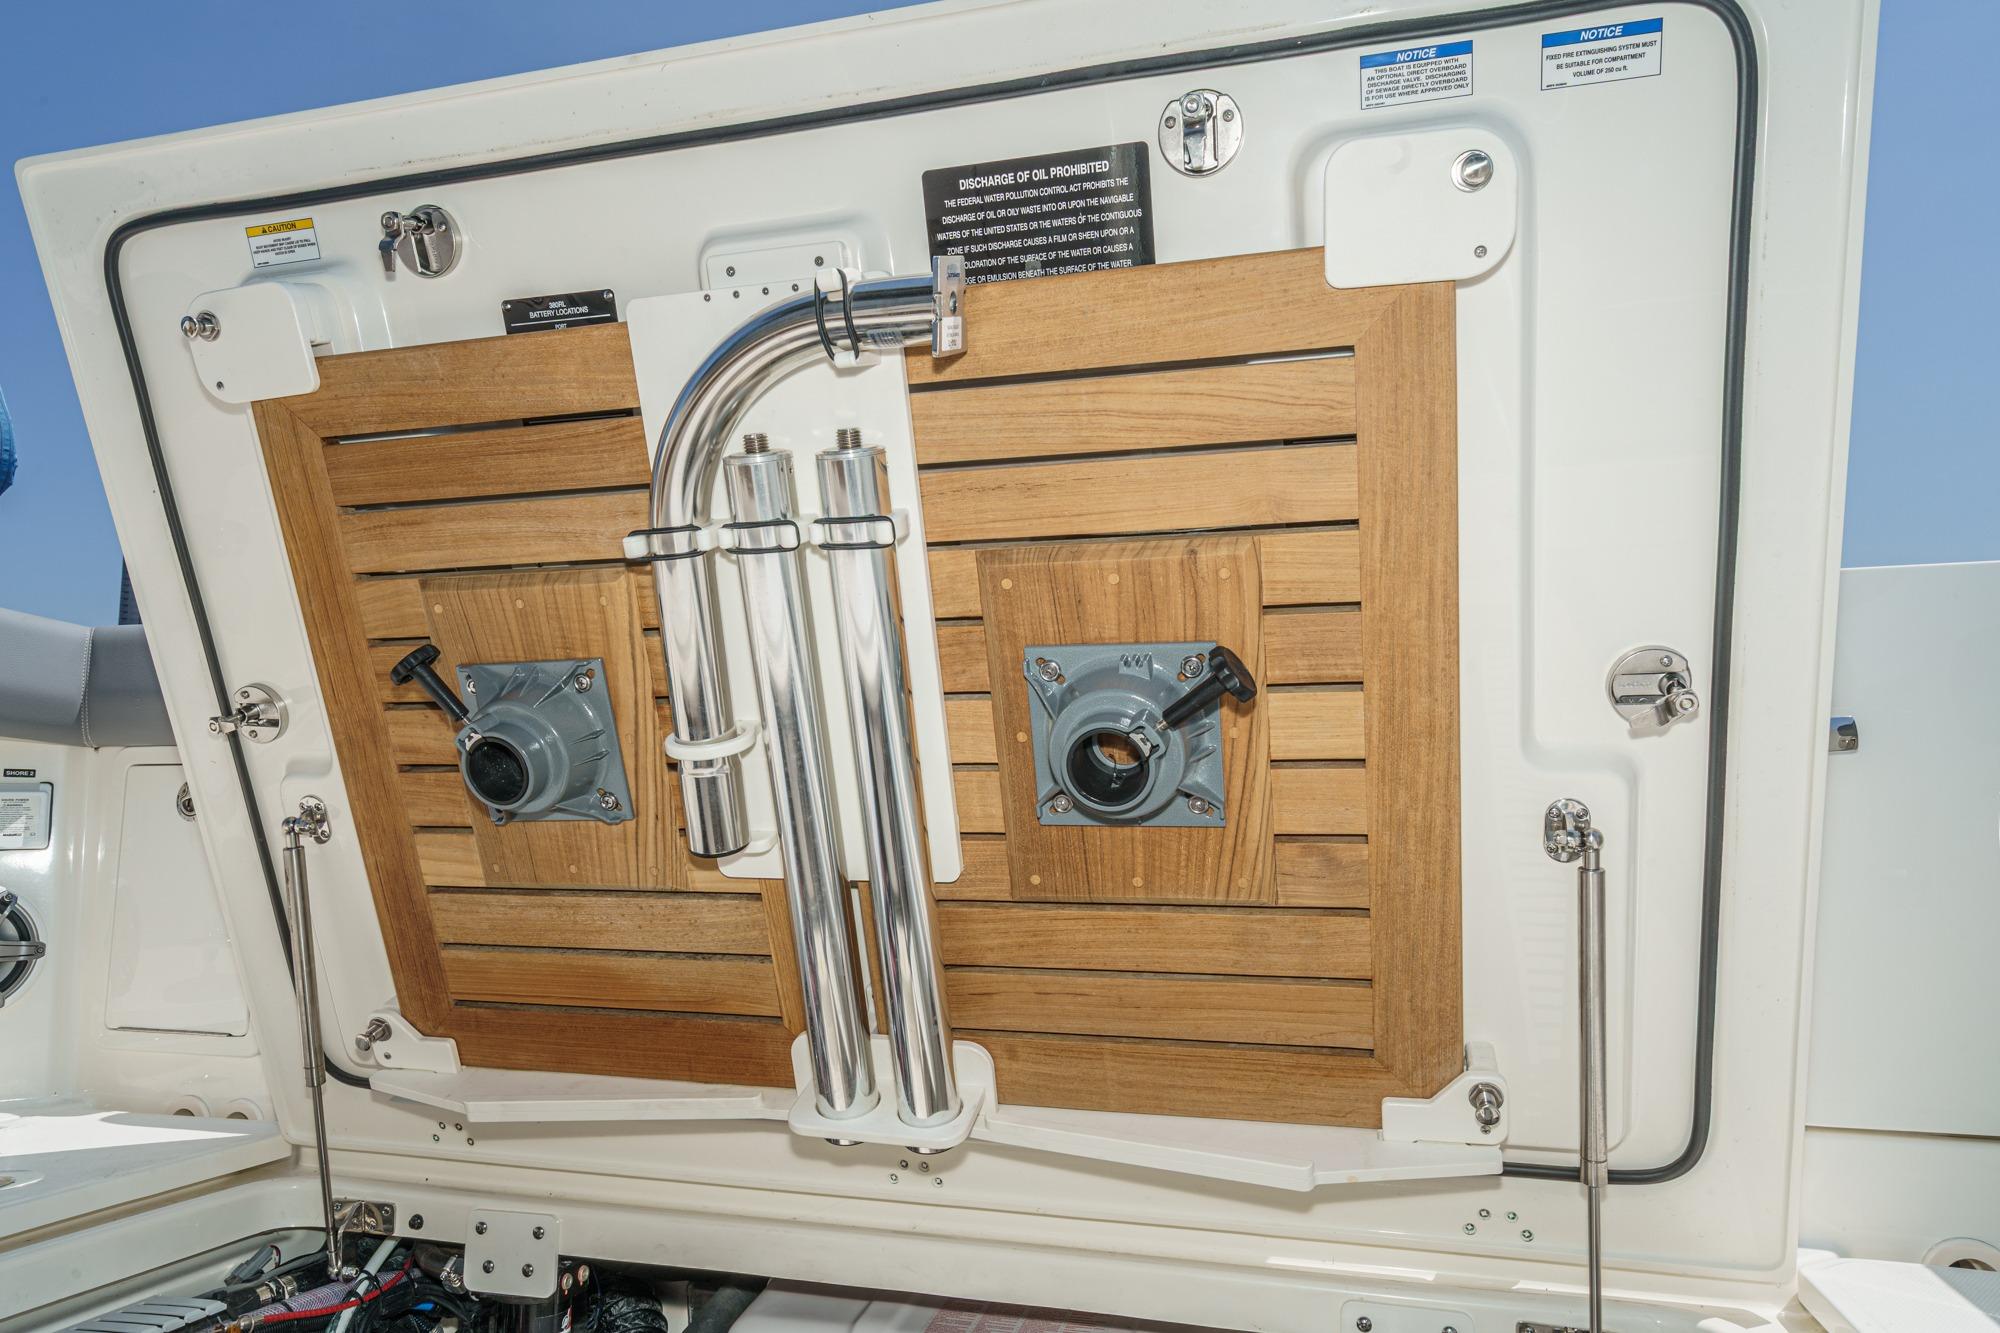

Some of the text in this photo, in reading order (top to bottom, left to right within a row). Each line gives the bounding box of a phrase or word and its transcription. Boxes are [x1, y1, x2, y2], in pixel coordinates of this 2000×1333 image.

[1580, 26, 1623, 40] NOTICE
[1397, 48, 1436, 62] NOTICE
[1576, 46, 1617, 57] EXTINGUISHING
[1619, 42, 1640, 51] SYSTEM
[1413, 60, 1442, 68] EQUIPPED
[1565, 60, 1590, 68] SUITABLE
[1604, 52, 1646, 63] COMPARTMENT
[1368, 79, 1401, 88] DISCHARGE
[1425, 70, 1466, 80] DISCHARGING
[1376, 72, 1405, 80] OPTIONAL
[1430, 63, 1467, 73] OVERBOARD
[1402, 82, 1429, 90] DIRECTLY
[1431, 77, 1468, 86] OVERBOARD
[1421, 85, 1452, 93] APPROVED
[959, 161, 1109, 190] DISCHARGE OF OIL PROHIBITED
[944, 177, 1128, 208] THE FEDERAL WATER POLLUTION CONTROL ACT PROHIBITS THE
[942, 193, 1134, 224] DISCHARGE OF OIL OR OILY WASTE INTO OR UPON THE NAVIGABLE
[268, 222, 296, 233] CAUTION
[937, 209, 1142, 241] WATERS OF THE UNITED STATES OR THE WATERS OF THE CONTIGUOUS
[947, 246, 963, 255] ZONE
[971, 244, 987, 253] SUCH
[988, 240, 1023, 251] DISCHARGE
[1023, 237, 1047, 246] CAUSES
[1048, 236, 1053, 244] A
[1054, 234, 1067, 243] FILM
[1068, 233, 1077, 241] OR
[1078, 230, 1099, 240] SHEEN
[1100, 228, 1118, 238] UPON
[1119, 227, 1128, 235] OR
[1129, 226, 1134, 234] A
[964, 259, 997, 269] OLORATION
[997, 258, 1006, 266] OF
[1007, 256, 1019, 265] THE
[1020, 252, 1047, 263] SURFACE
[1048, 252, 1056, 260] OF
[1058, 250, 1070, 259] THE
[1070, 248, 1092, 257] WATER
[1092, 247, 1102, 255] OR
[1102, 244, 1128, 254] CAUSES
[977, 274, 986, 283] OR
[987, 272, 1017, 283] EMULSION
[1018, 269, 1044, 279] BENEATH
[1046, 267, 1058, 275] THE
[1058, 264, 1087, 274] SURFACE
[1088, 263, 1097, 271] OF
[1097, 261, 1110, 270] THE
[529, 306, 588, 318] BATTERY LOCATIONS
